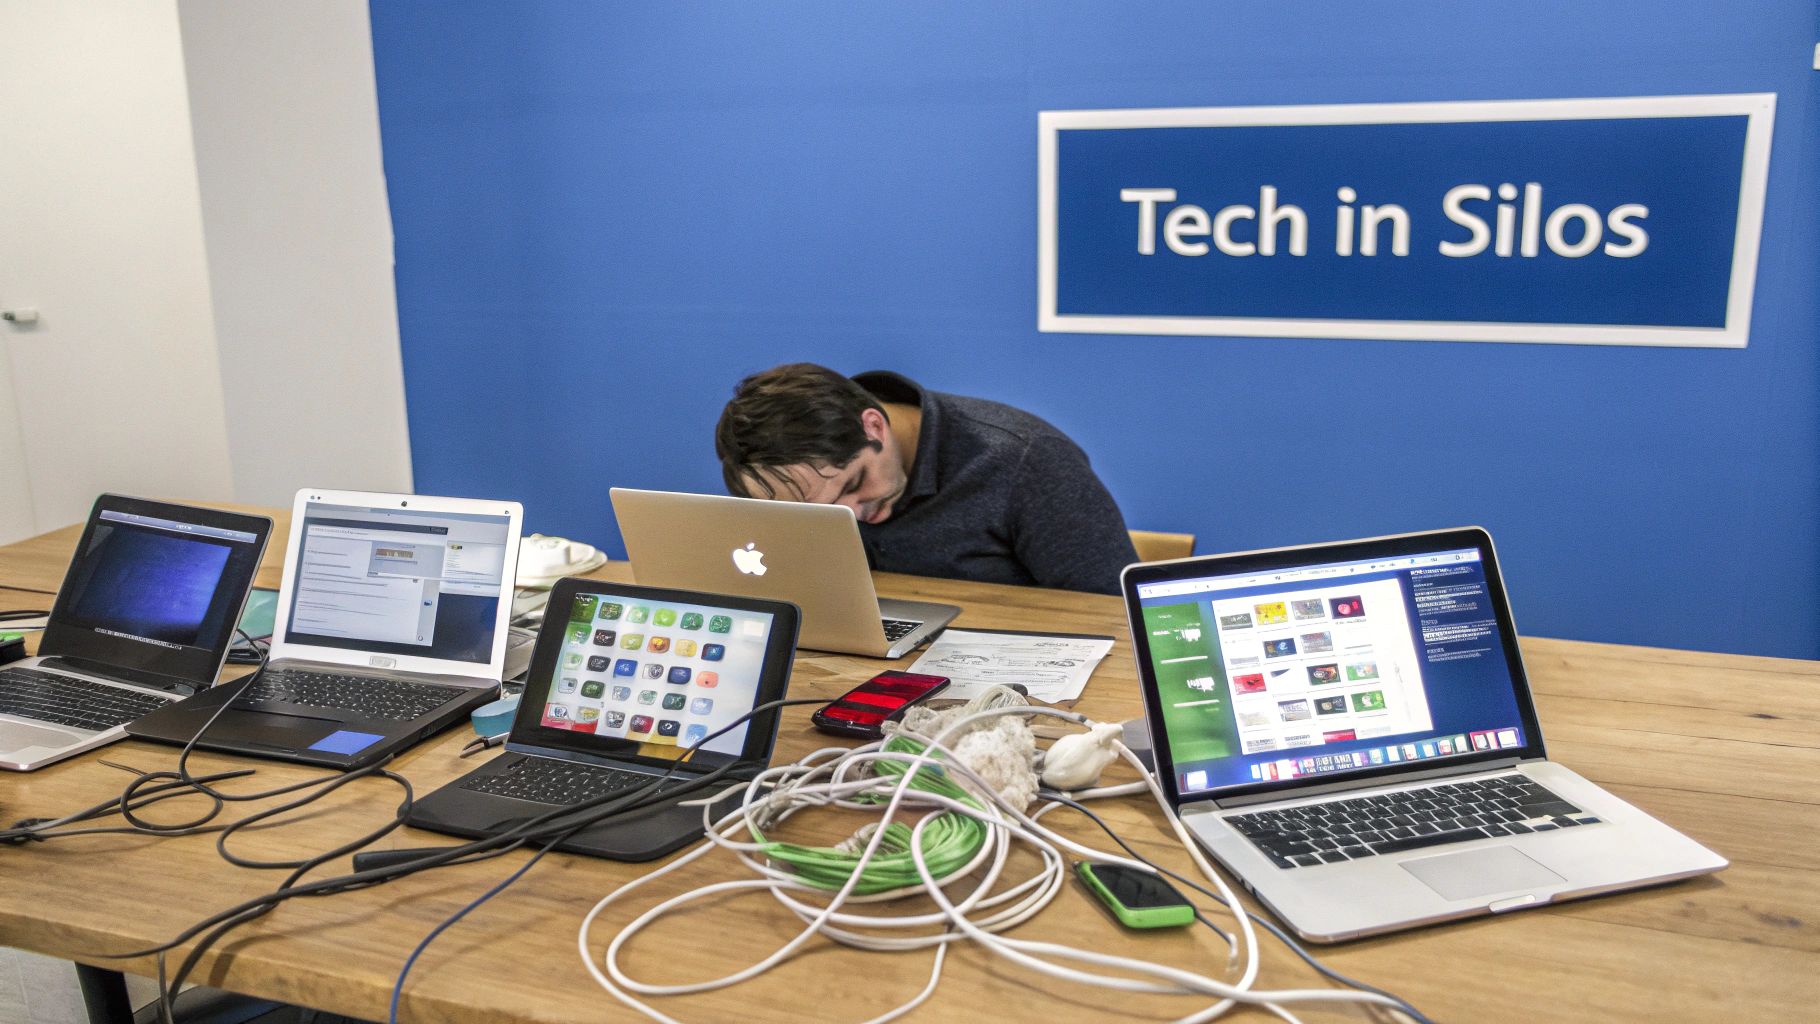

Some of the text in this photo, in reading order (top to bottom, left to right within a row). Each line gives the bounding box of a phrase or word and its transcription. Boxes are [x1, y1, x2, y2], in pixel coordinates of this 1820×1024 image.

[1119, 182, 1649, 258] Tech in Silos
